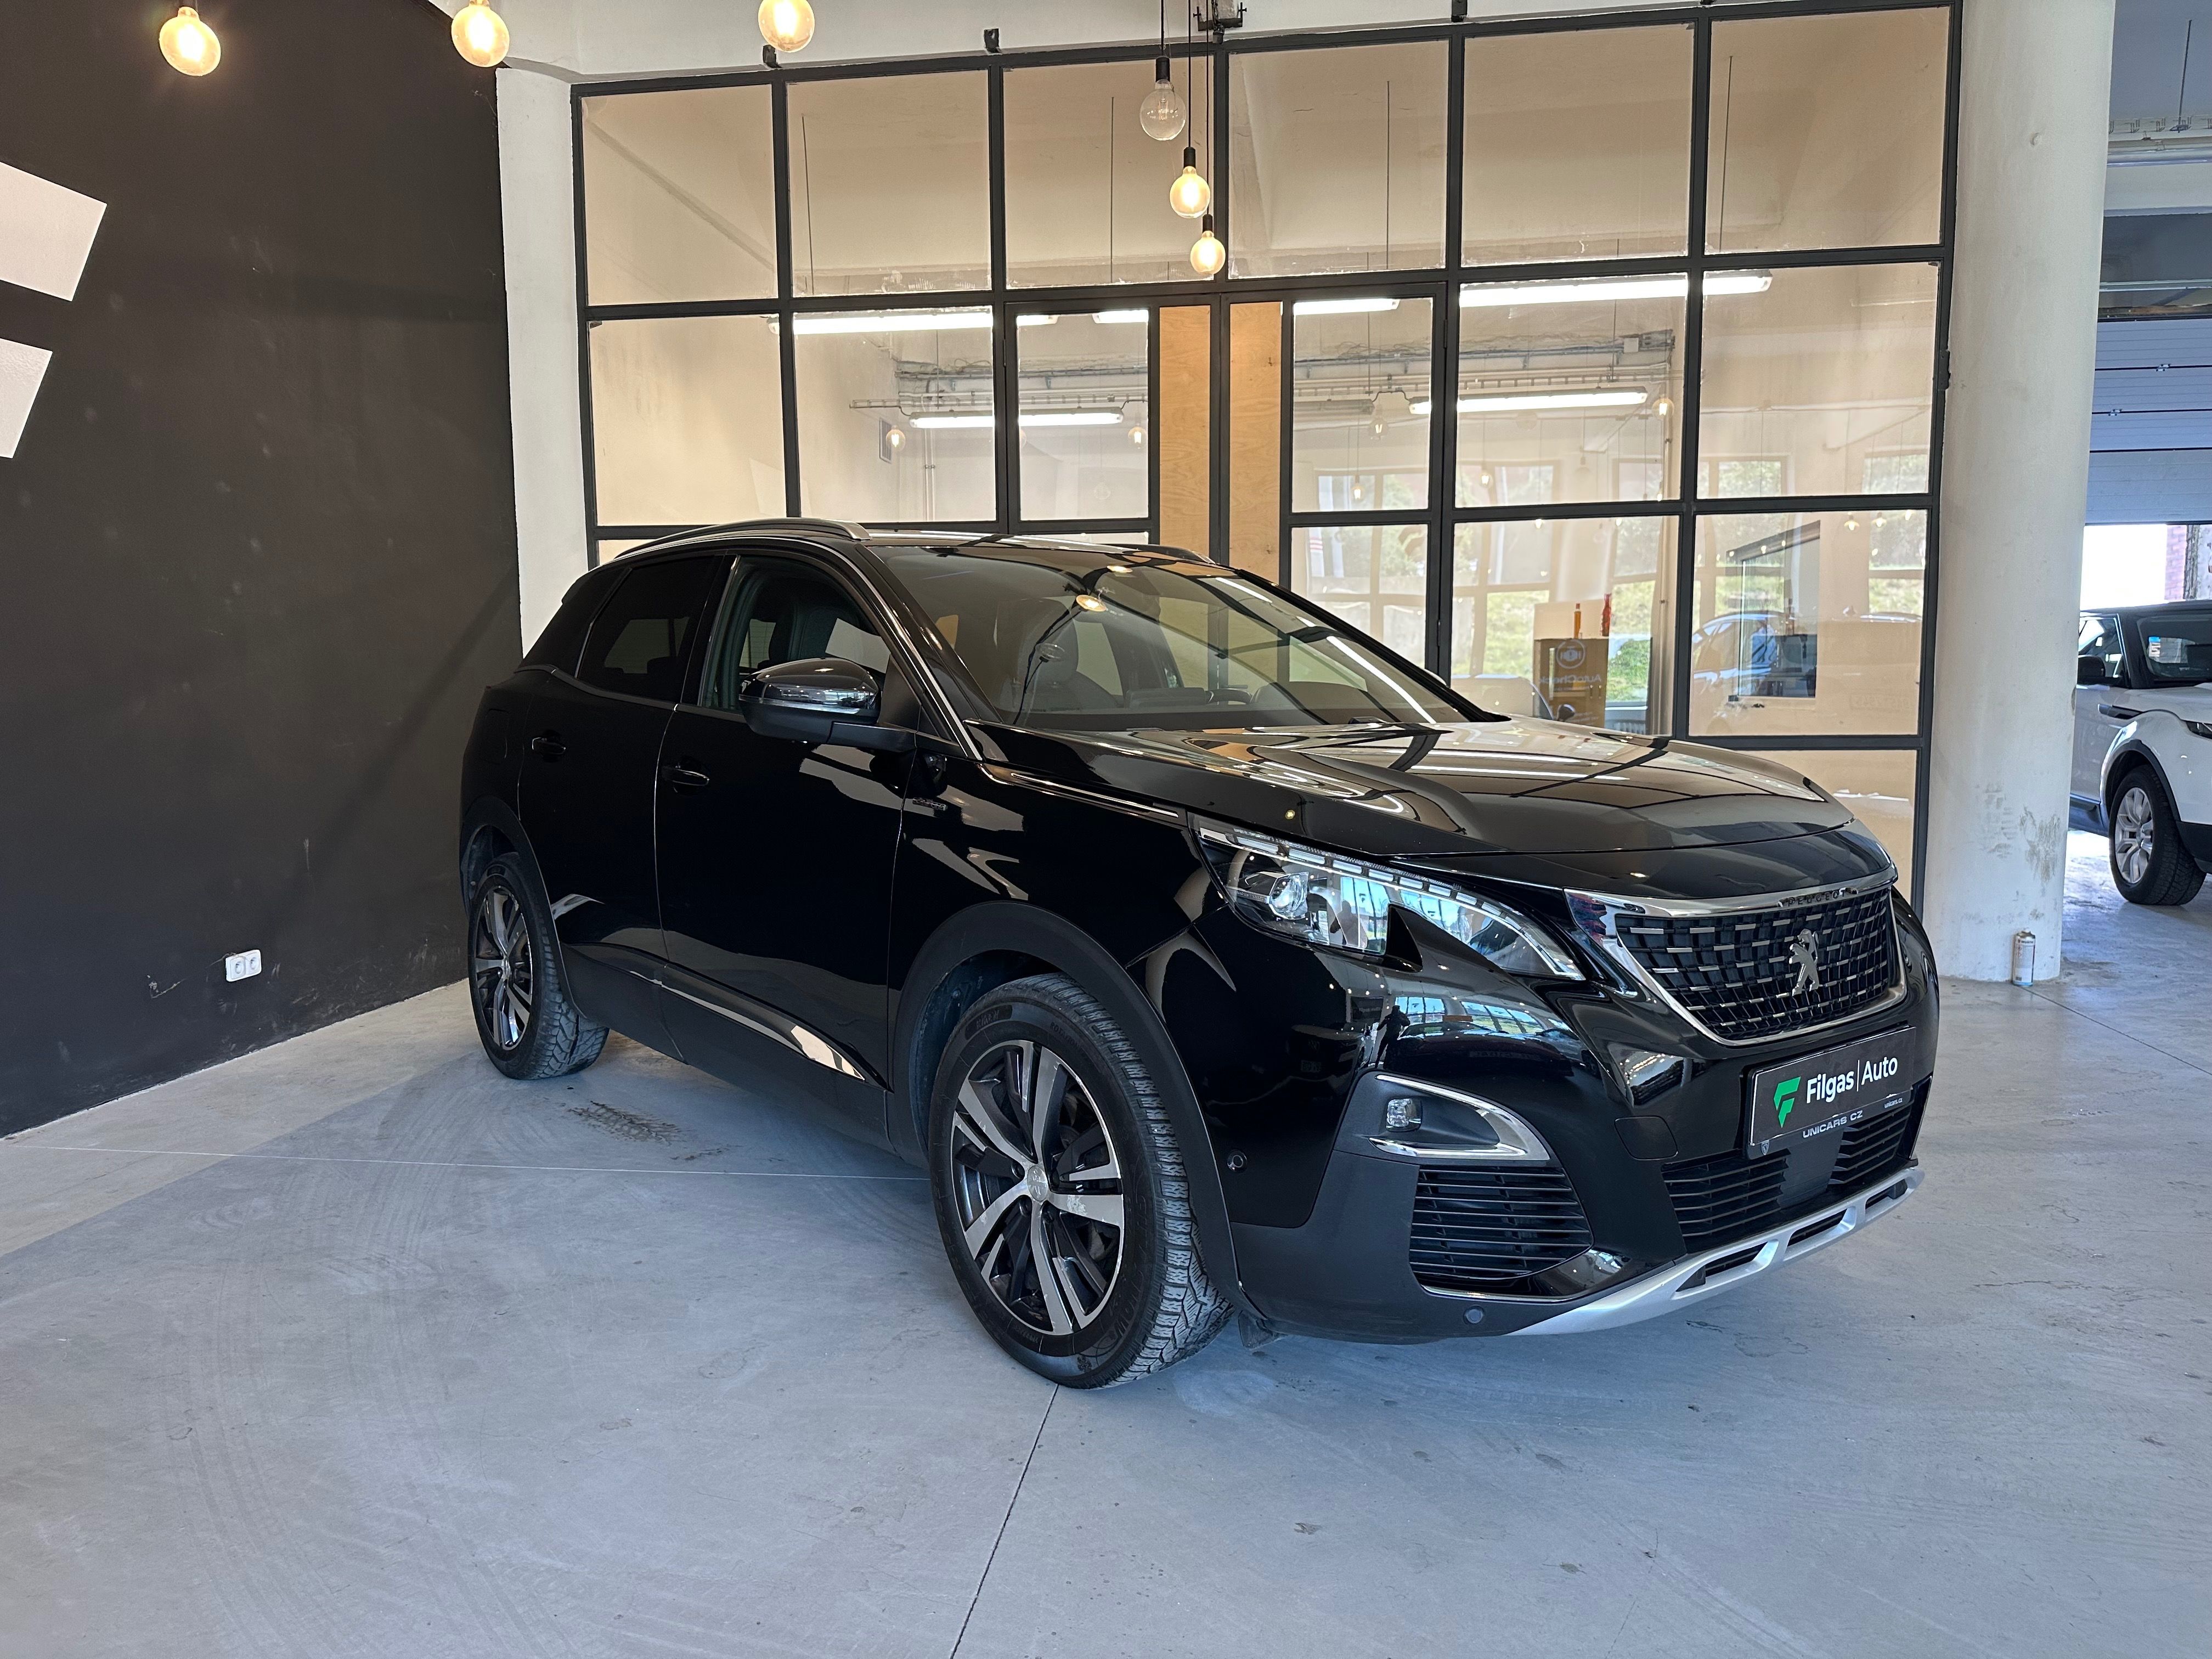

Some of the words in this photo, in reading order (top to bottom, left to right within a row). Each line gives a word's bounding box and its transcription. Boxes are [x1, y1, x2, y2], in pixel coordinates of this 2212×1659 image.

[1788, 888, 1846, 907] PEUGEOT
[1807, 1071, 1854, 1104] Filgas
[1861, 1057, 1898, 1085] Auto
[1803, 1116, 1847, 1138] UNICARS
[1850, 1110, 1863, 1121] CZ
